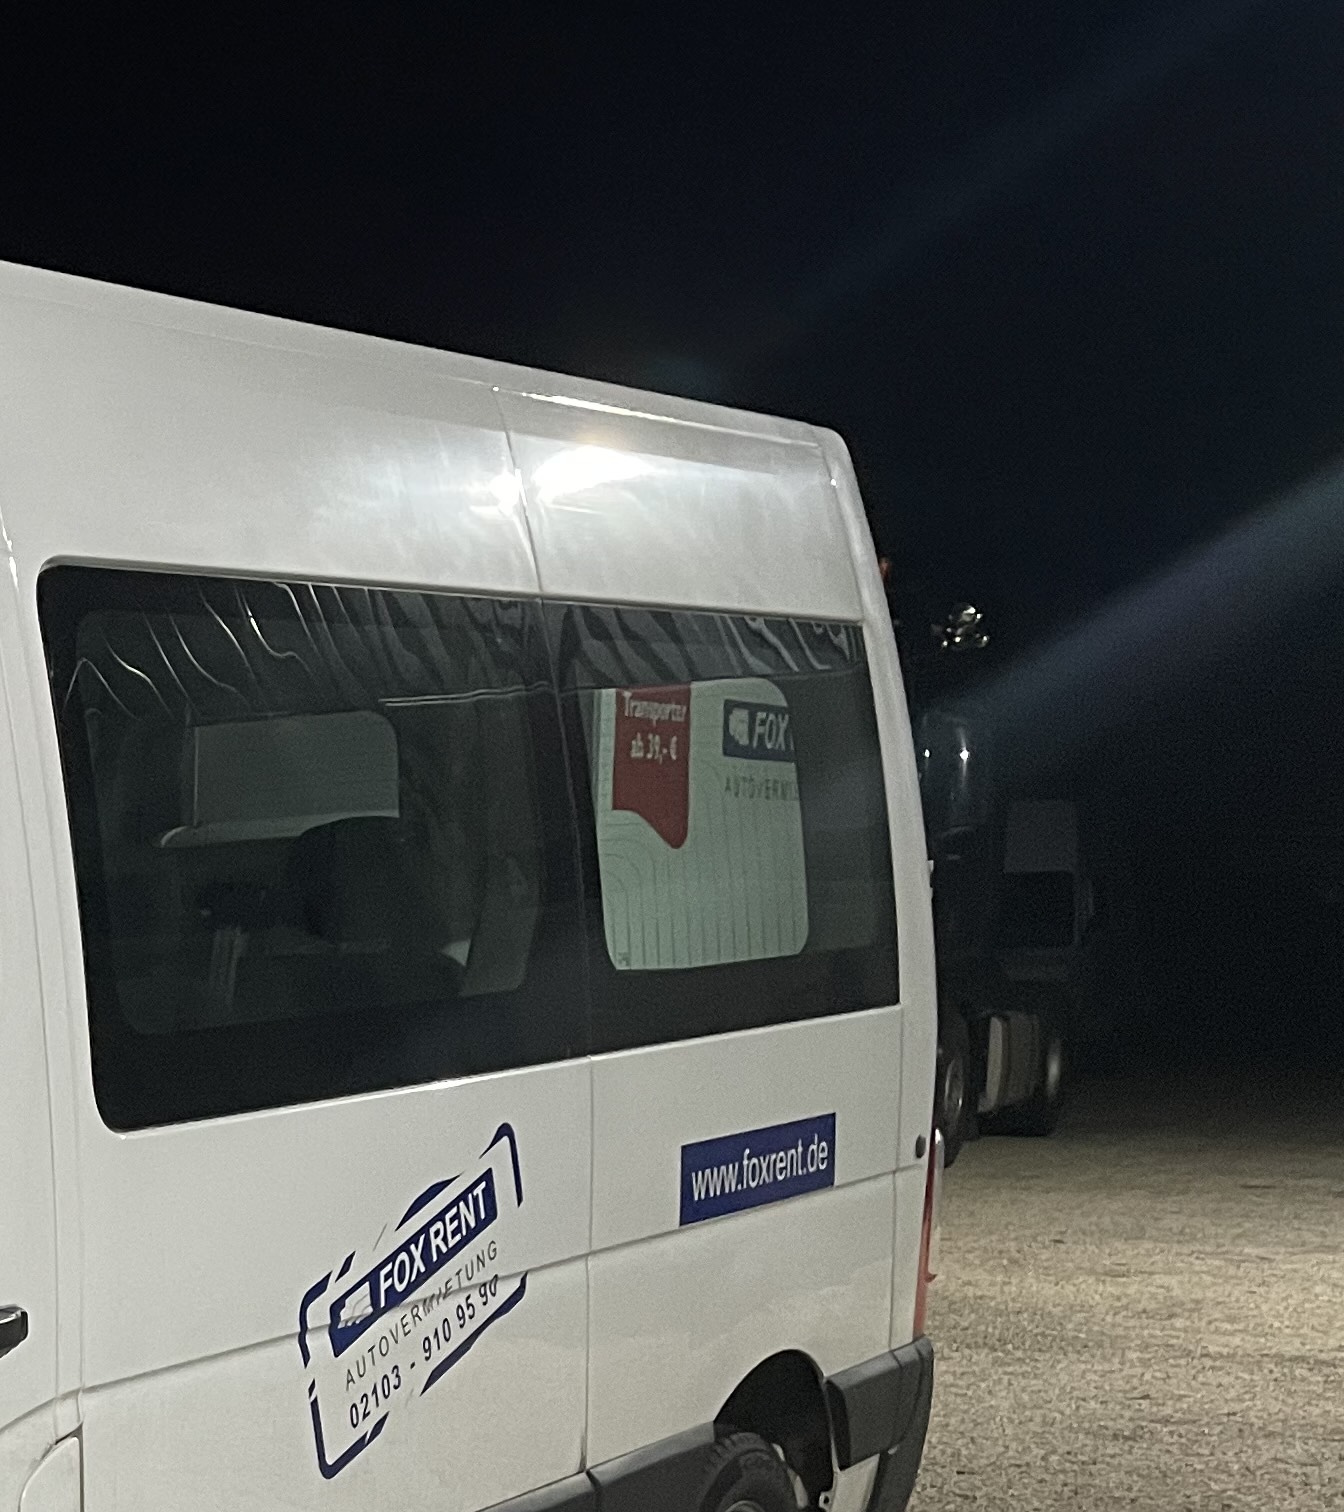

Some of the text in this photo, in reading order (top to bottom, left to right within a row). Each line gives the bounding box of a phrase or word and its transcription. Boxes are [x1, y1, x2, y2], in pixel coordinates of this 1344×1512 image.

[622, 690, 687, 727] Transporter
[752, 711, 790, 751] FOX
[630, 732, 644, 758] ab
[691, 1132, 829, 1202] www.foxrent.de
[378, 1181, 487, 1308] FOX RENT
[345, 1240, 498, 1392] AUTOVERMIETUNG
[349, 1364, 402, 1429] 02103
[422, 1317, 452, 1361] 910
[455, 1294, 476, 1329] 95
[478, 1273, 500, 1307] 90
